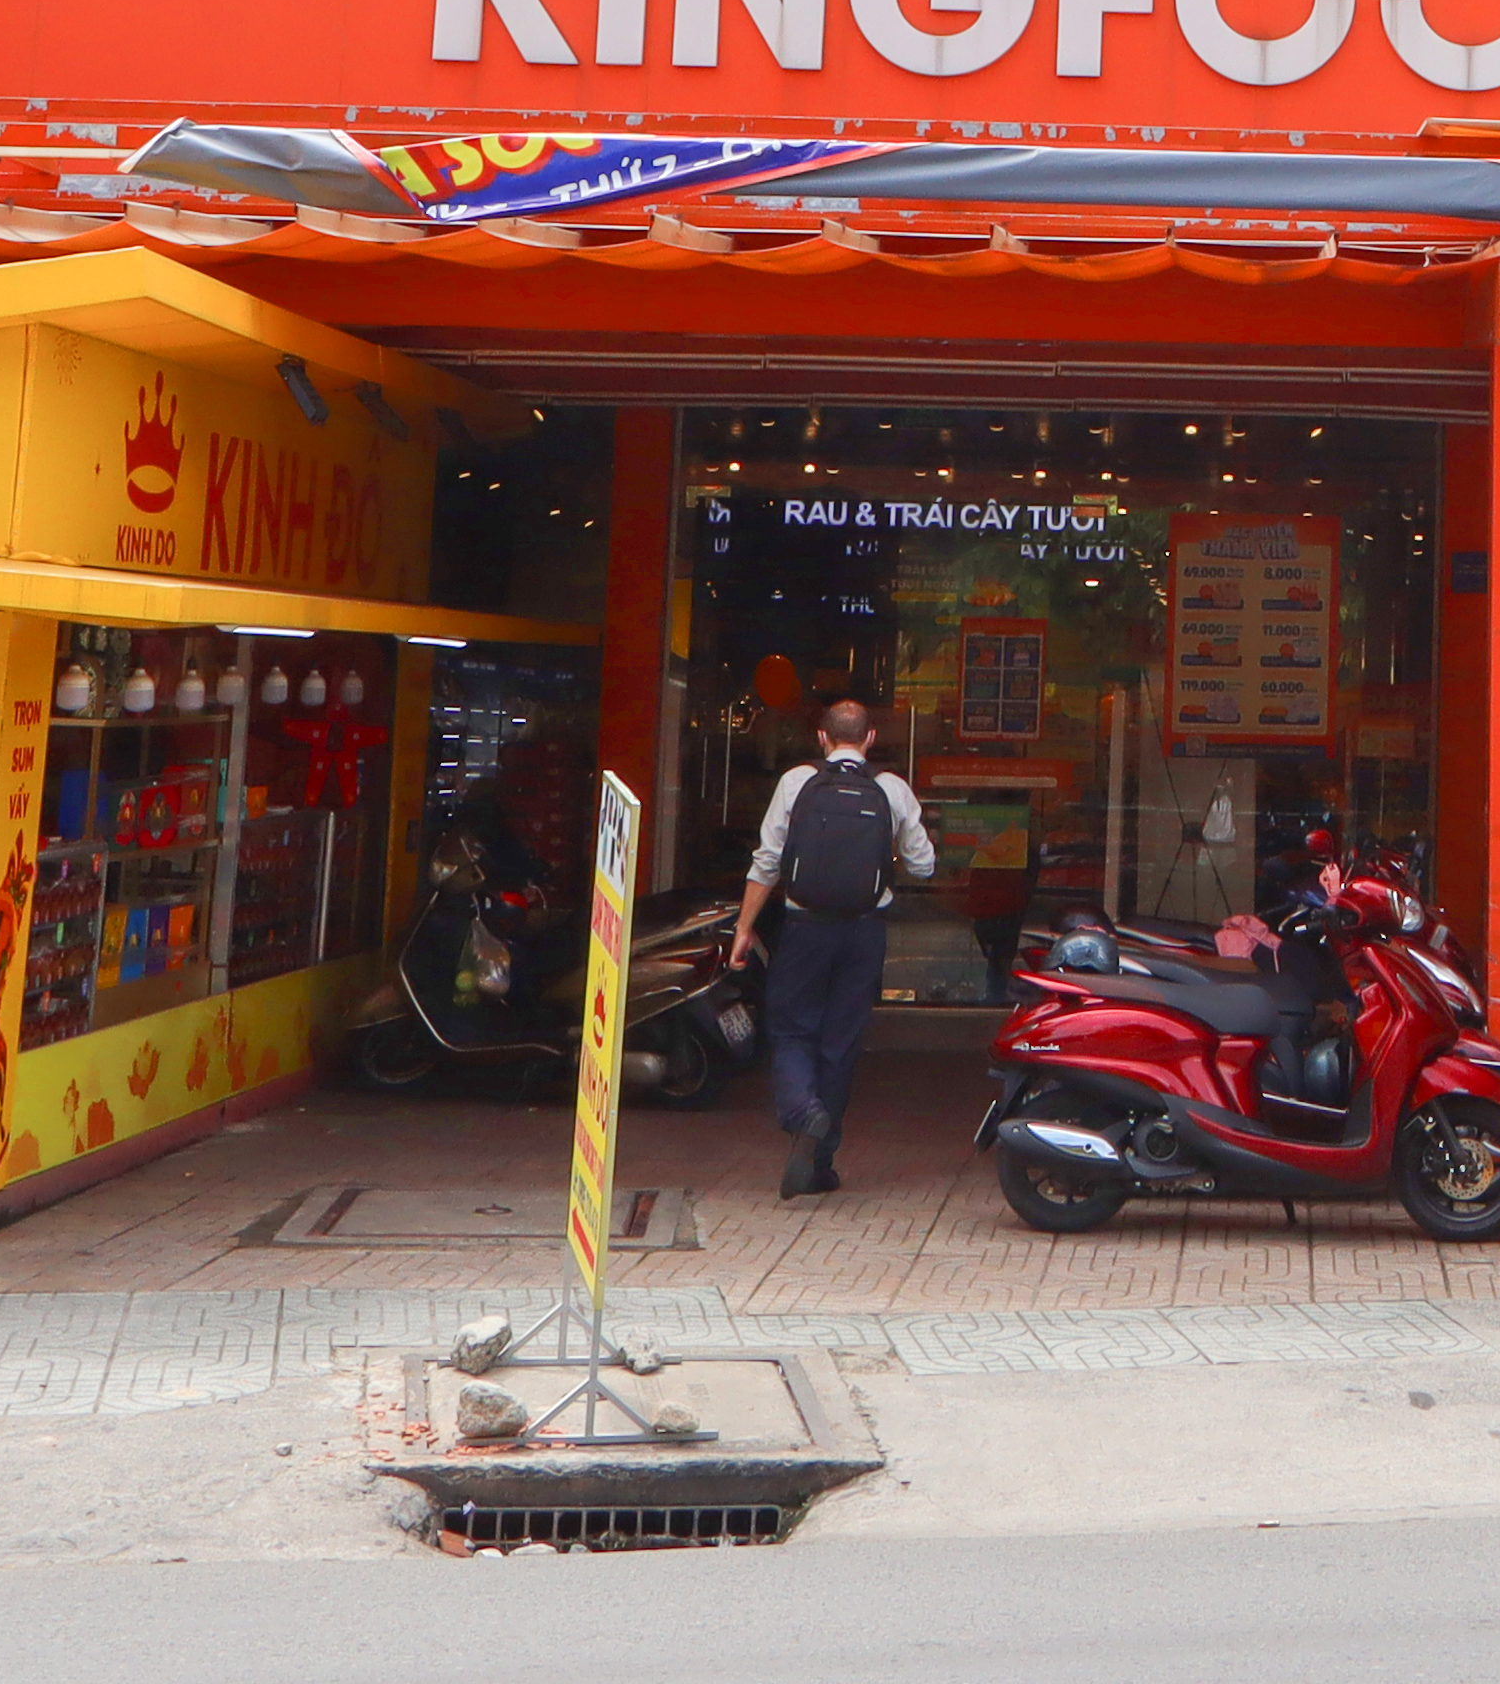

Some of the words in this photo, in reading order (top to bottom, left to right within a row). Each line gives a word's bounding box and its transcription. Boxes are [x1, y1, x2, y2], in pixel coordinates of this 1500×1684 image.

[200, 431, 319, 581] KINH
[784, 499, 849, 526] RAU
[855, 501, 877, 526] &
[884, 496, 953, 528] TRÁI
[960, 498, 1020, 531] CÂY
[116, 524, 151, 564] KINH
[154, 529, 176, 566] DO
[13, 699, 42, 732] TRỌN
[11, 746, 35, 773] SUM
